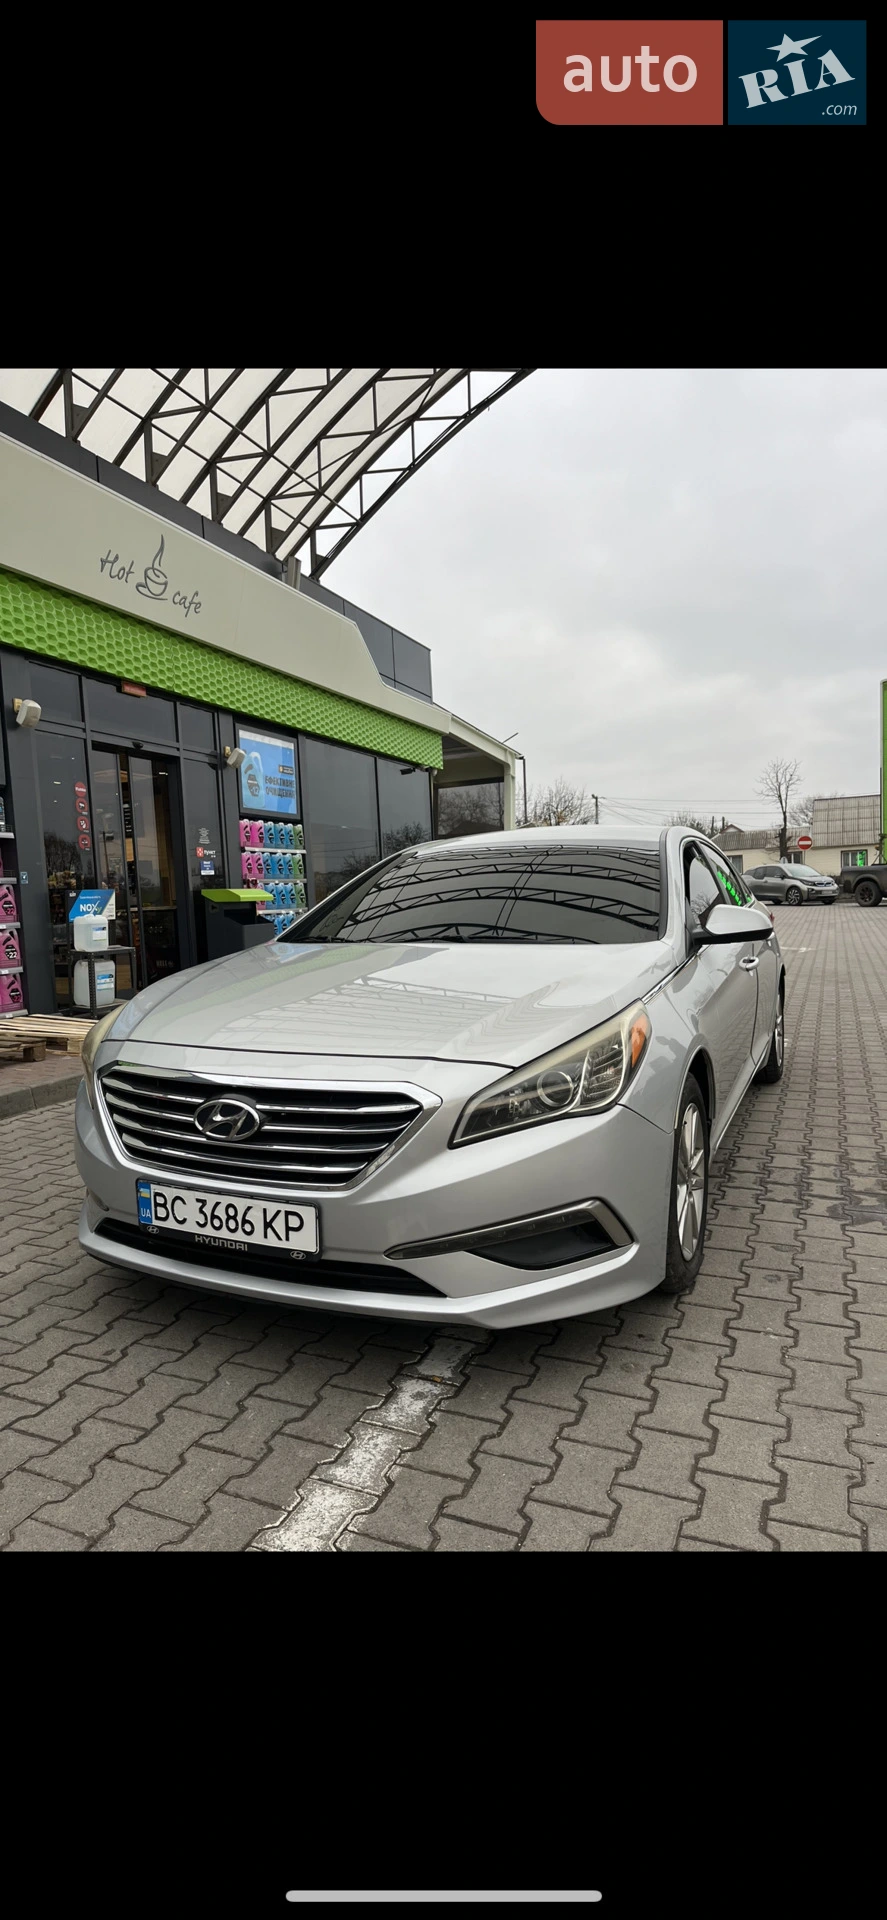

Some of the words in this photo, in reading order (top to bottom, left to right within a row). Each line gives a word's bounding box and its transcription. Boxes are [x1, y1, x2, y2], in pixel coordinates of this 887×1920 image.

[100, 549, 135, 583] Hot
[172, 590, 202, 618] cafe
[140, 1207, 151, 1219] UA
[153, 1191, 188, 1226] BC
[195, 1197, 255, 1237] 3686
[262, 1207, 304, 1242] KP
[194, 1234, 248, 1252] HYUNDAI
